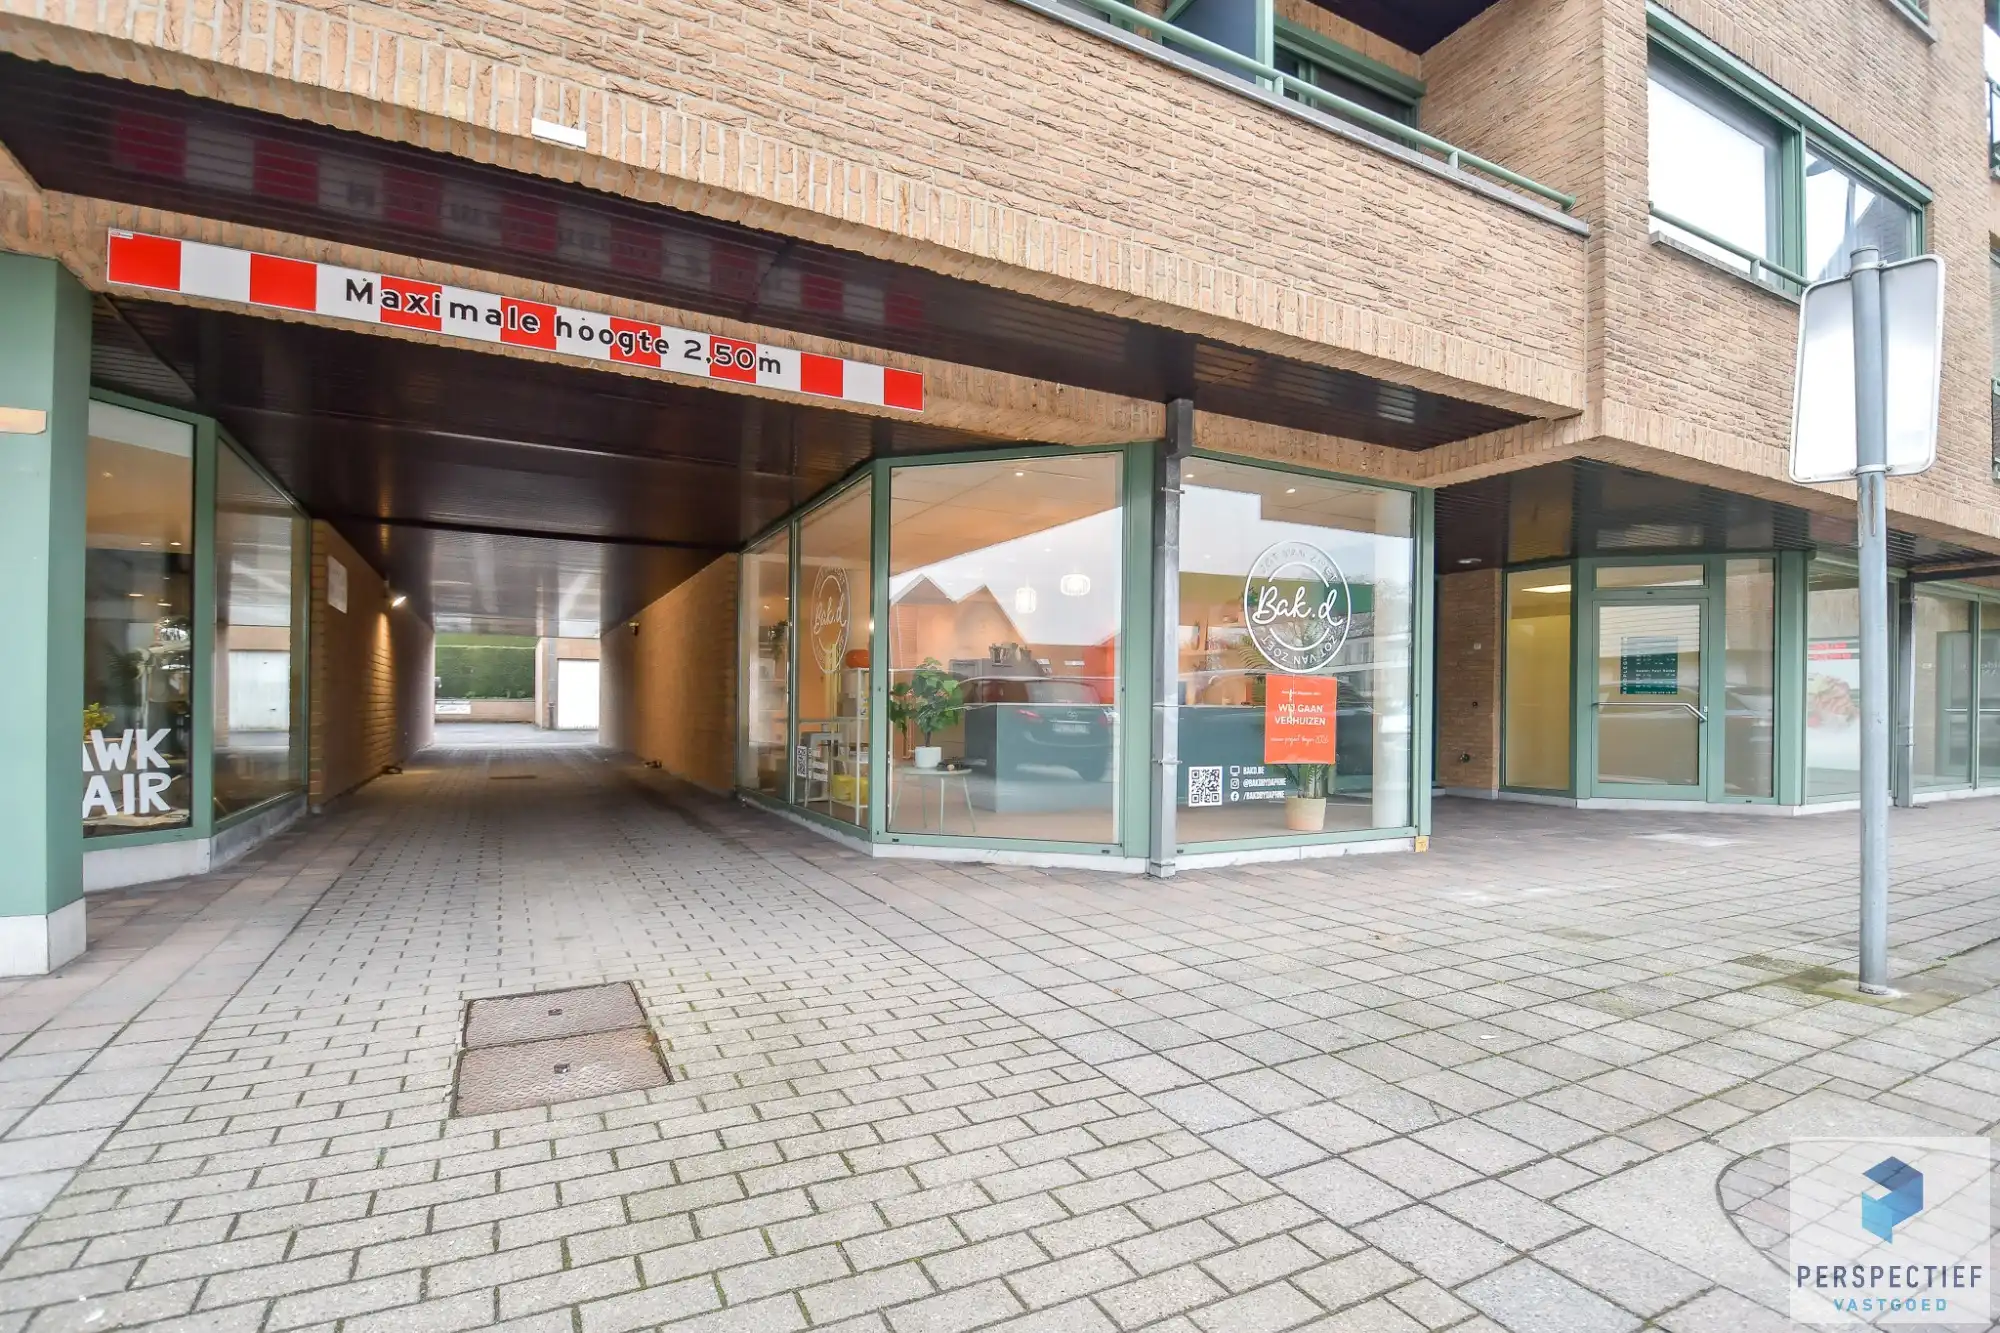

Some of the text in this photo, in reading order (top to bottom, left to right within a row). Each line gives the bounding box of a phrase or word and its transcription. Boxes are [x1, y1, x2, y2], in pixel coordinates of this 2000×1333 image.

[346, 278, 782, 375] Maximale hoogte 2,50m
[1252, 586, 1343, 626] Bak.d
[1260, 634, 1337, 665] ZOT VAN ZOET
[1275, 716, 1326, 725] VERHUIZEN
[1297, 704, 1323, 713] GAAN
